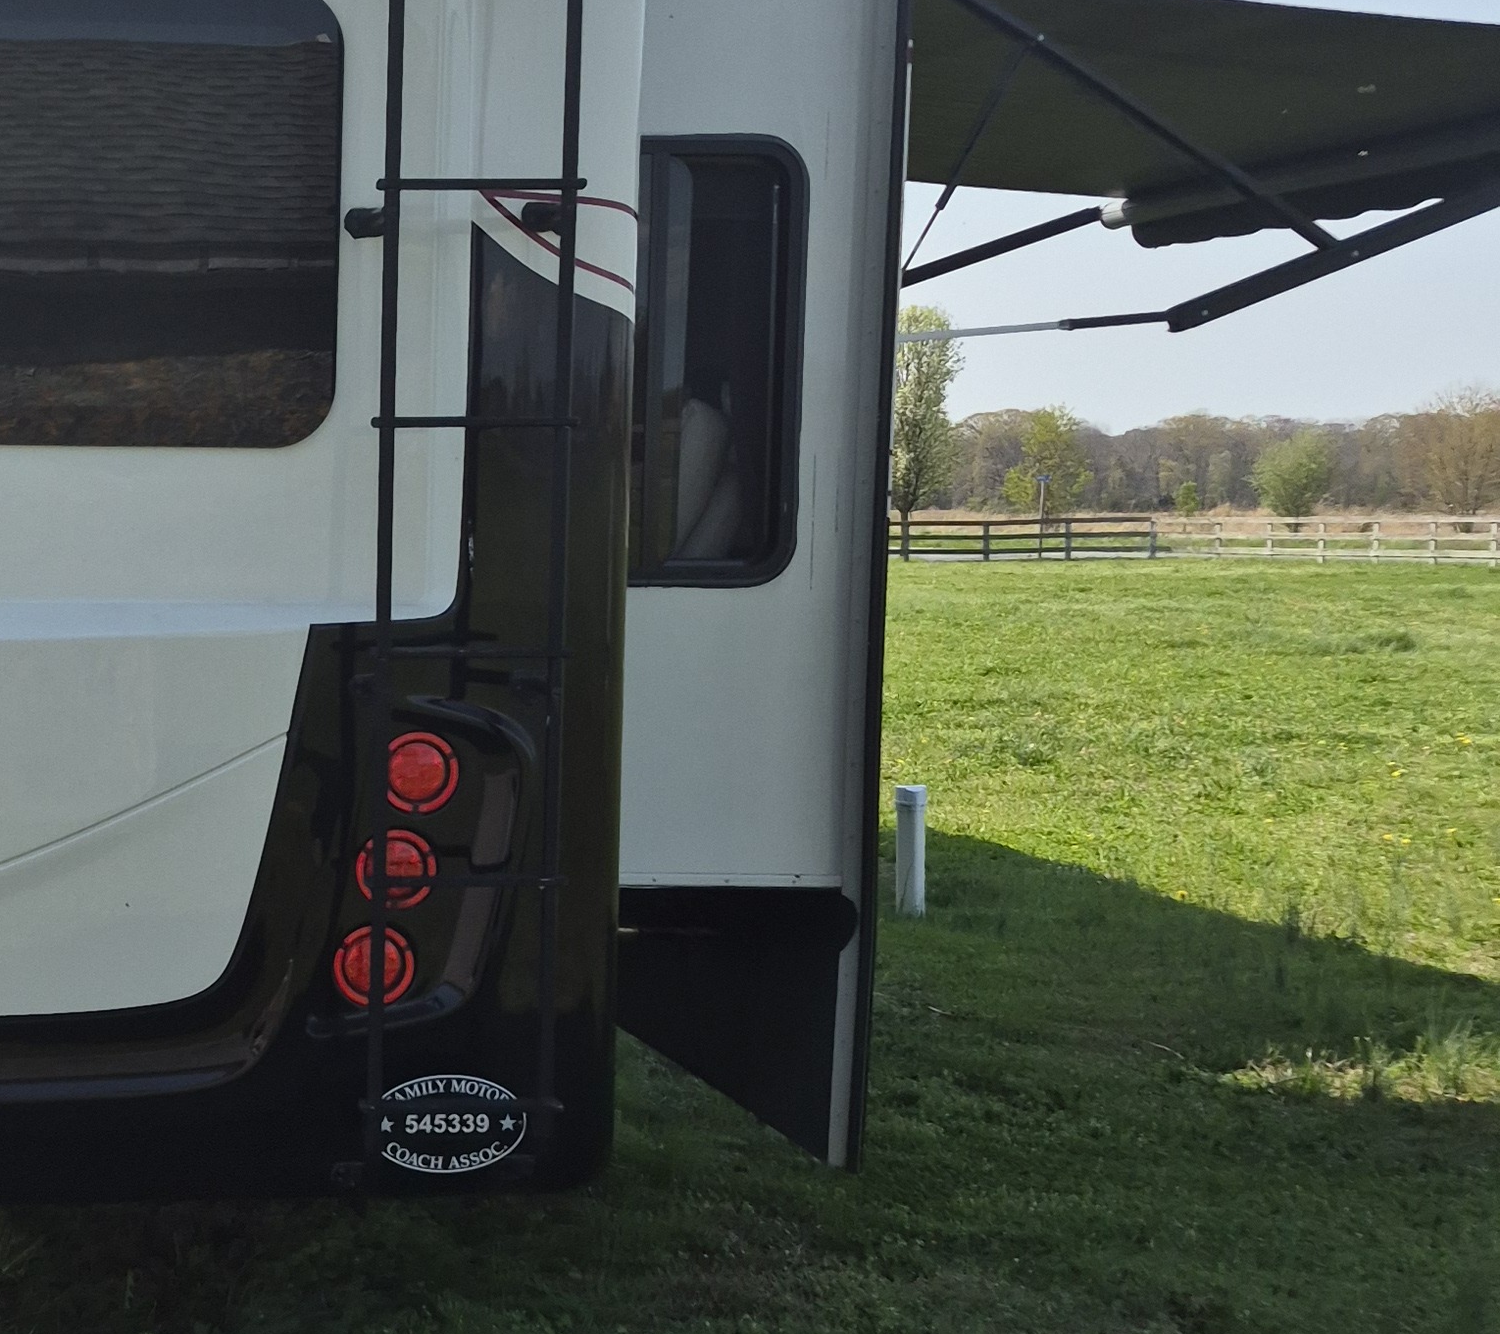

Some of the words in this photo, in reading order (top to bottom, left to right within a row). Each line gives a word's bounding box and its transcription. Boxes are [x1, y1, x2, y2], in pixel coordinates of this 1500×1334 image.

[385, 1079, 447, 1101] AMILY
[404, 1113, 490, 1134] 545339
[386, 1141, 444, 1170] COACH
[447, 1140, 508, 1170] ASSOC.
